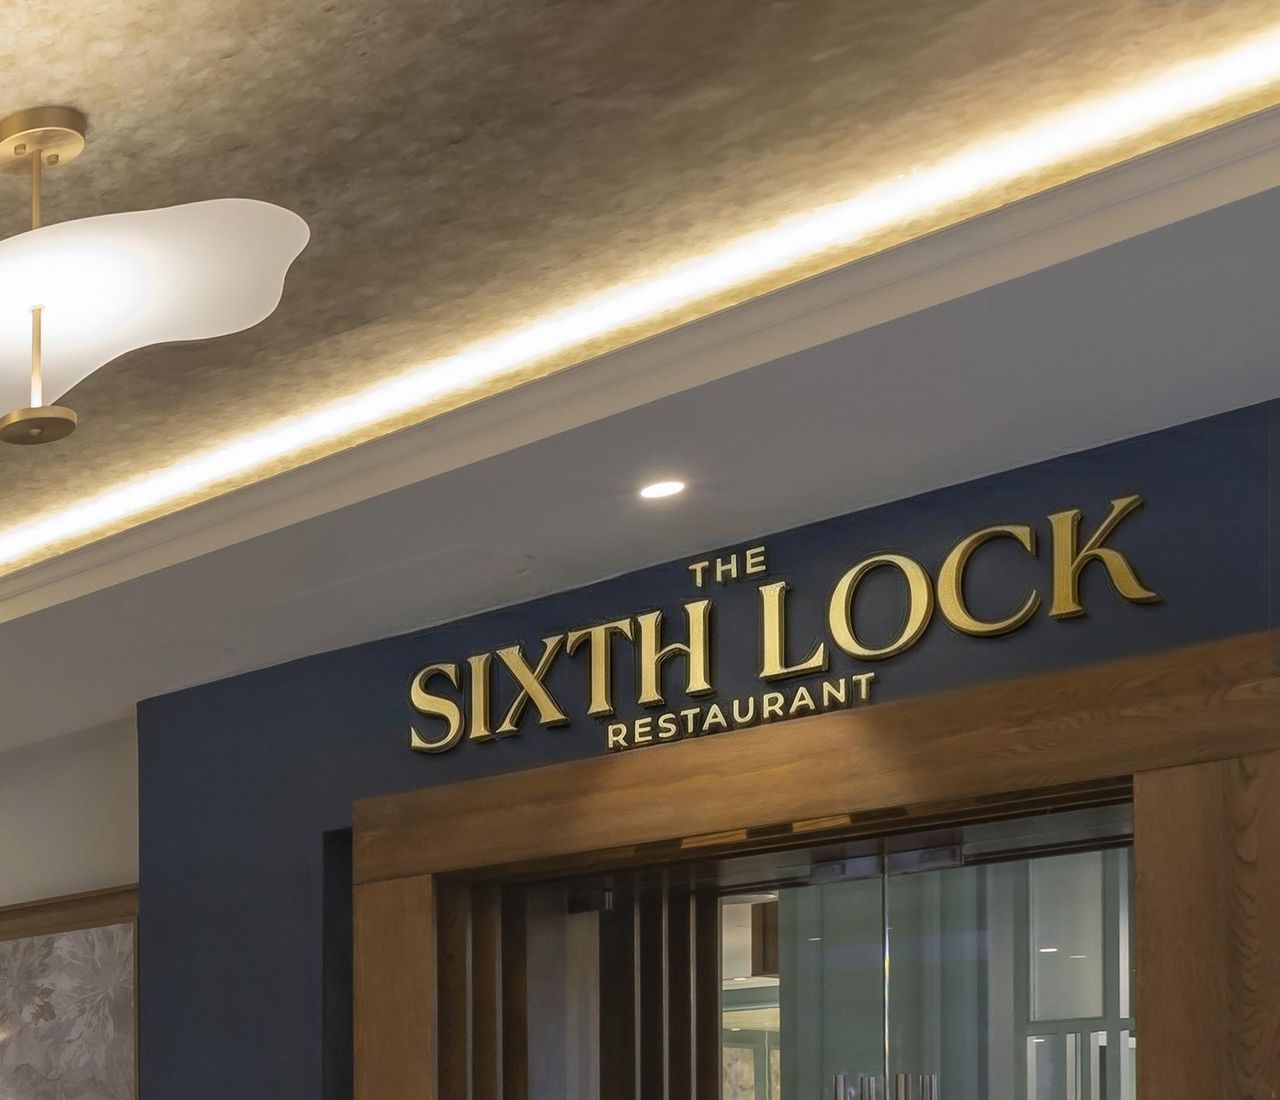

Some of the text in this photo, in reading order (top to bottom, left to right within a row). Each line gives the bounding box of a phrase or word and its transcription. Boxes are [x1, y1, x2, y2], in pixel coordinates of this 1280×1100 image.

[688, 546, 768, 588] THE
[408, 493, 1164, 754] SIXTH LOCK
[607, 672, 877, 750] RESTAURANT
